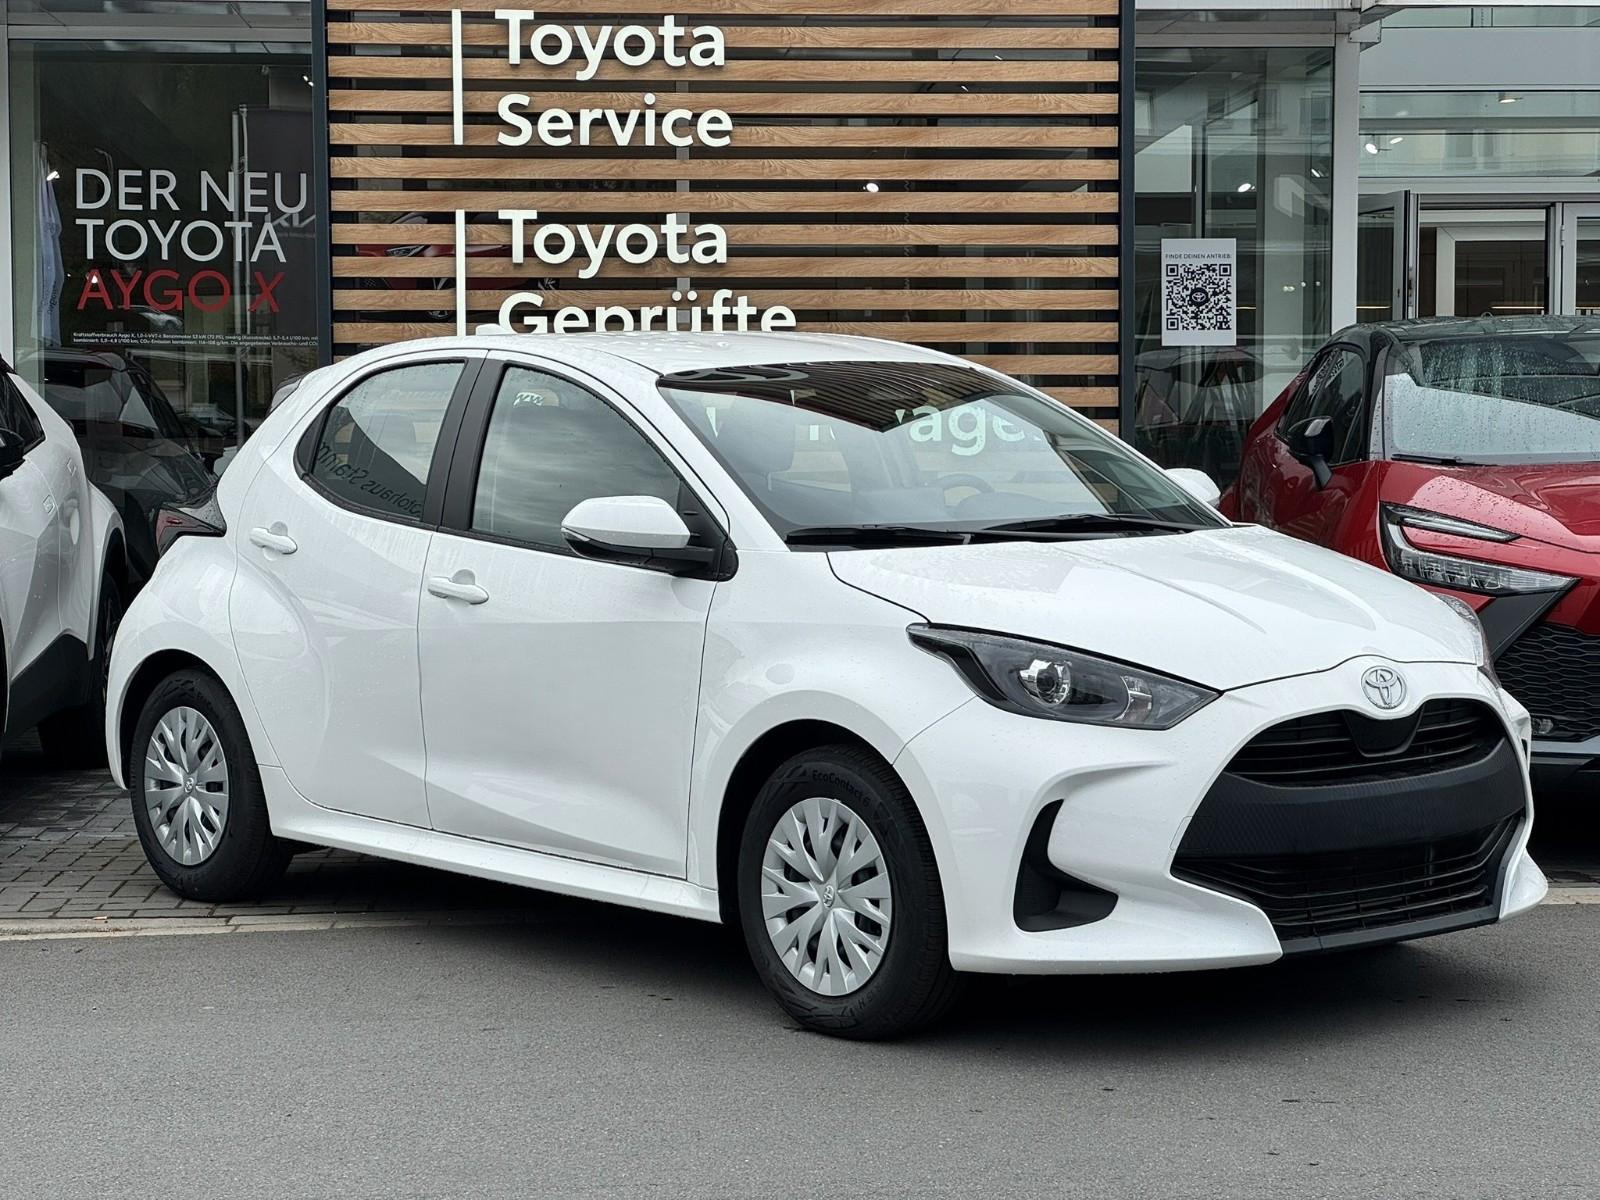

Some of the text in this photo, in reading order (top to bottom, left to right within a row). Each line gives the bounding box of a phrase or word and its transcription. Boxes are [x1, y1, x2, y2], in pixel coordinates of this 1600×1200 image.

[495, 9, 725, 81] Toyota
[497, 92, 733, 147] Service
[75, 168, 307, 213] DER NEU
[75, 218, 286, 263] TOYOTA
[498, 209, 727, 279] Toyota
[76, 269, 231, 312] AYGO
[247, 271, 286, 312] X
[812, 769, 863, 801] EcoContact
